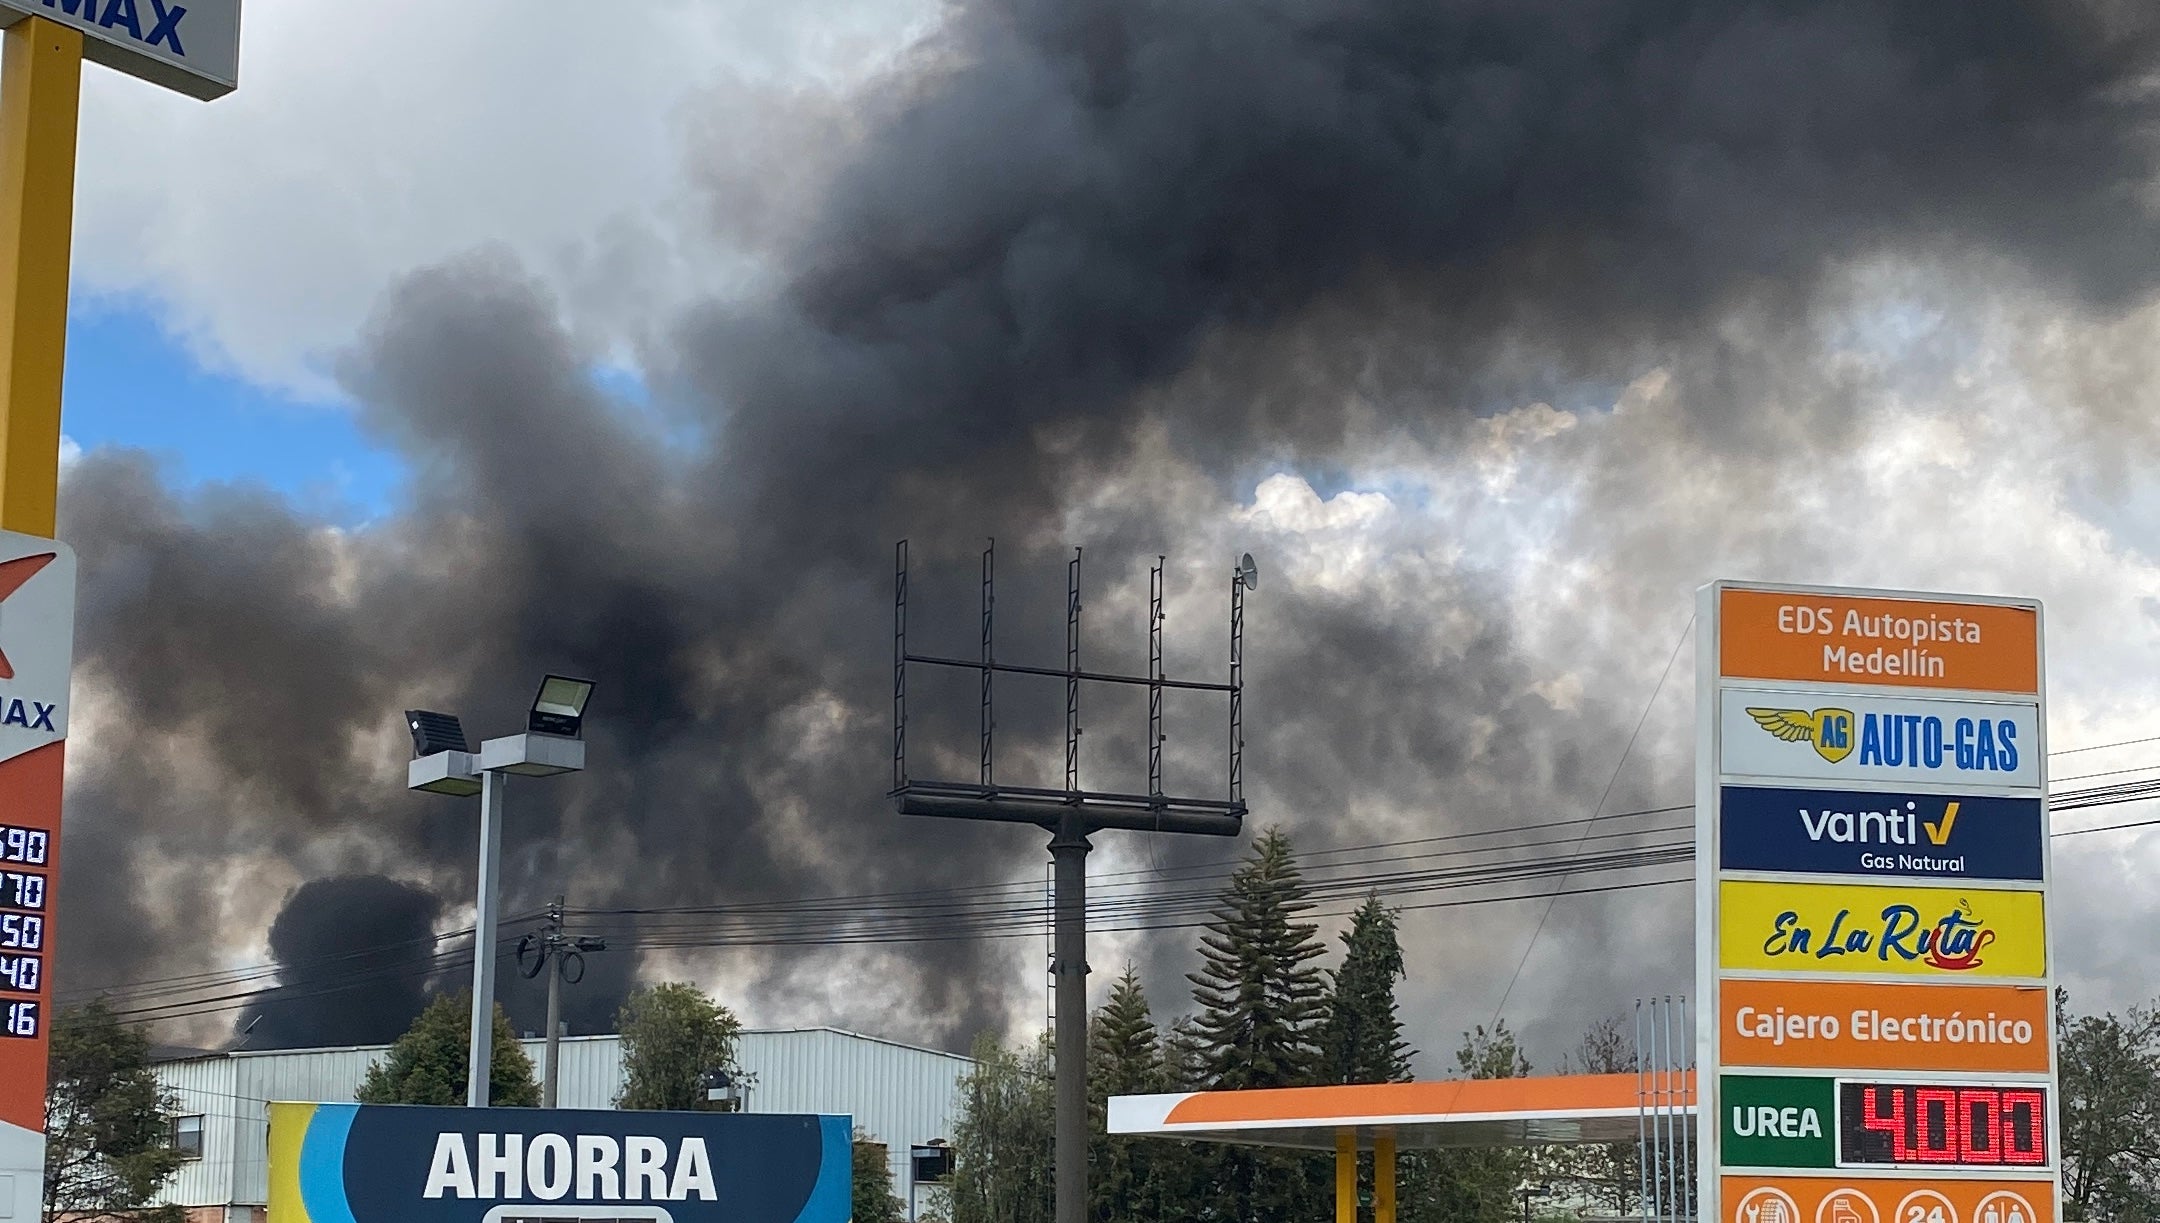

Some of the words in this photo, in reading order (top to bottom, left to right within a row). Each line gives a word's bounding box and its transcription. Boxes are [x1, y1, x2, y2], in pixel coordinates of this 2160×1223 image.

[1777, 605, 1833, 635] EDS
[1843, 609, 1981, 645] Autopista
[1823, 645, 1944, 678] Medellín
[1820, 715, 1848, 748] AG
[1859, 713, 2018, 772] AUTO-GAS
[1799, 801, 1917, 845] vanti
[0, 827, 46, 864] 90
[1861, 852, 1895, 870] Gas
[1899, 854, 1965, 872] Natural
[1764, 911, 1811, 956] En
[1816, 909, 1874, 959] La
[1878, 904, 1985, 961] Ruta
[1736, 1007, 1839, 1046] Cajero
[1851, 1009, 2032, 1044] Electrónico
[1733, 1106, 1822, 1138] UREA
[423, 1132, 718, 1200] AHORRA
